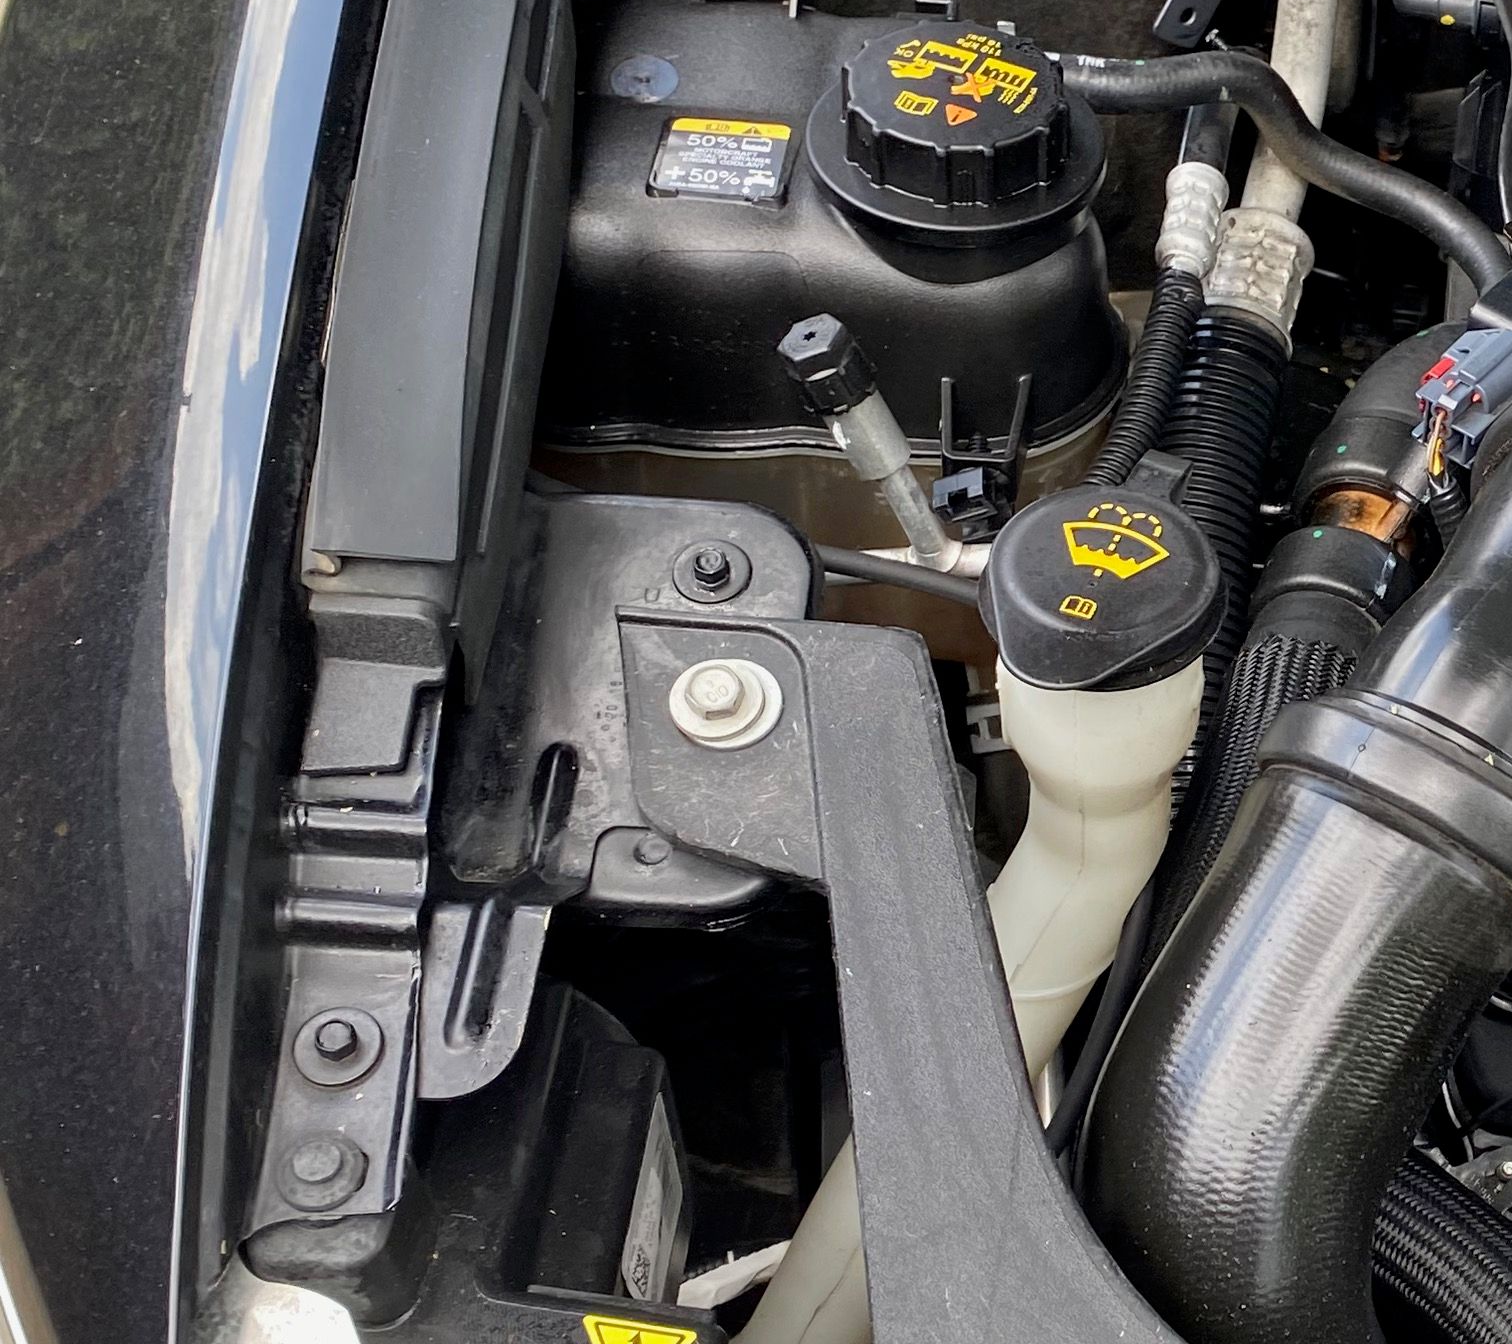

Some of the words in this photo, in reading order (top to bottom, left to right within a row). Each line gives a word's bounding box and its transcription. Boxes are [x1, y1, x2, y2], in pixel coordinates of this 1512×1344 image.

[894, 48, 914, 58] OK
[686, 134, 738, 149] 50%
[682, 157, 717, 165] ENGINE
[719, 160, 765, 168] COOLANT
